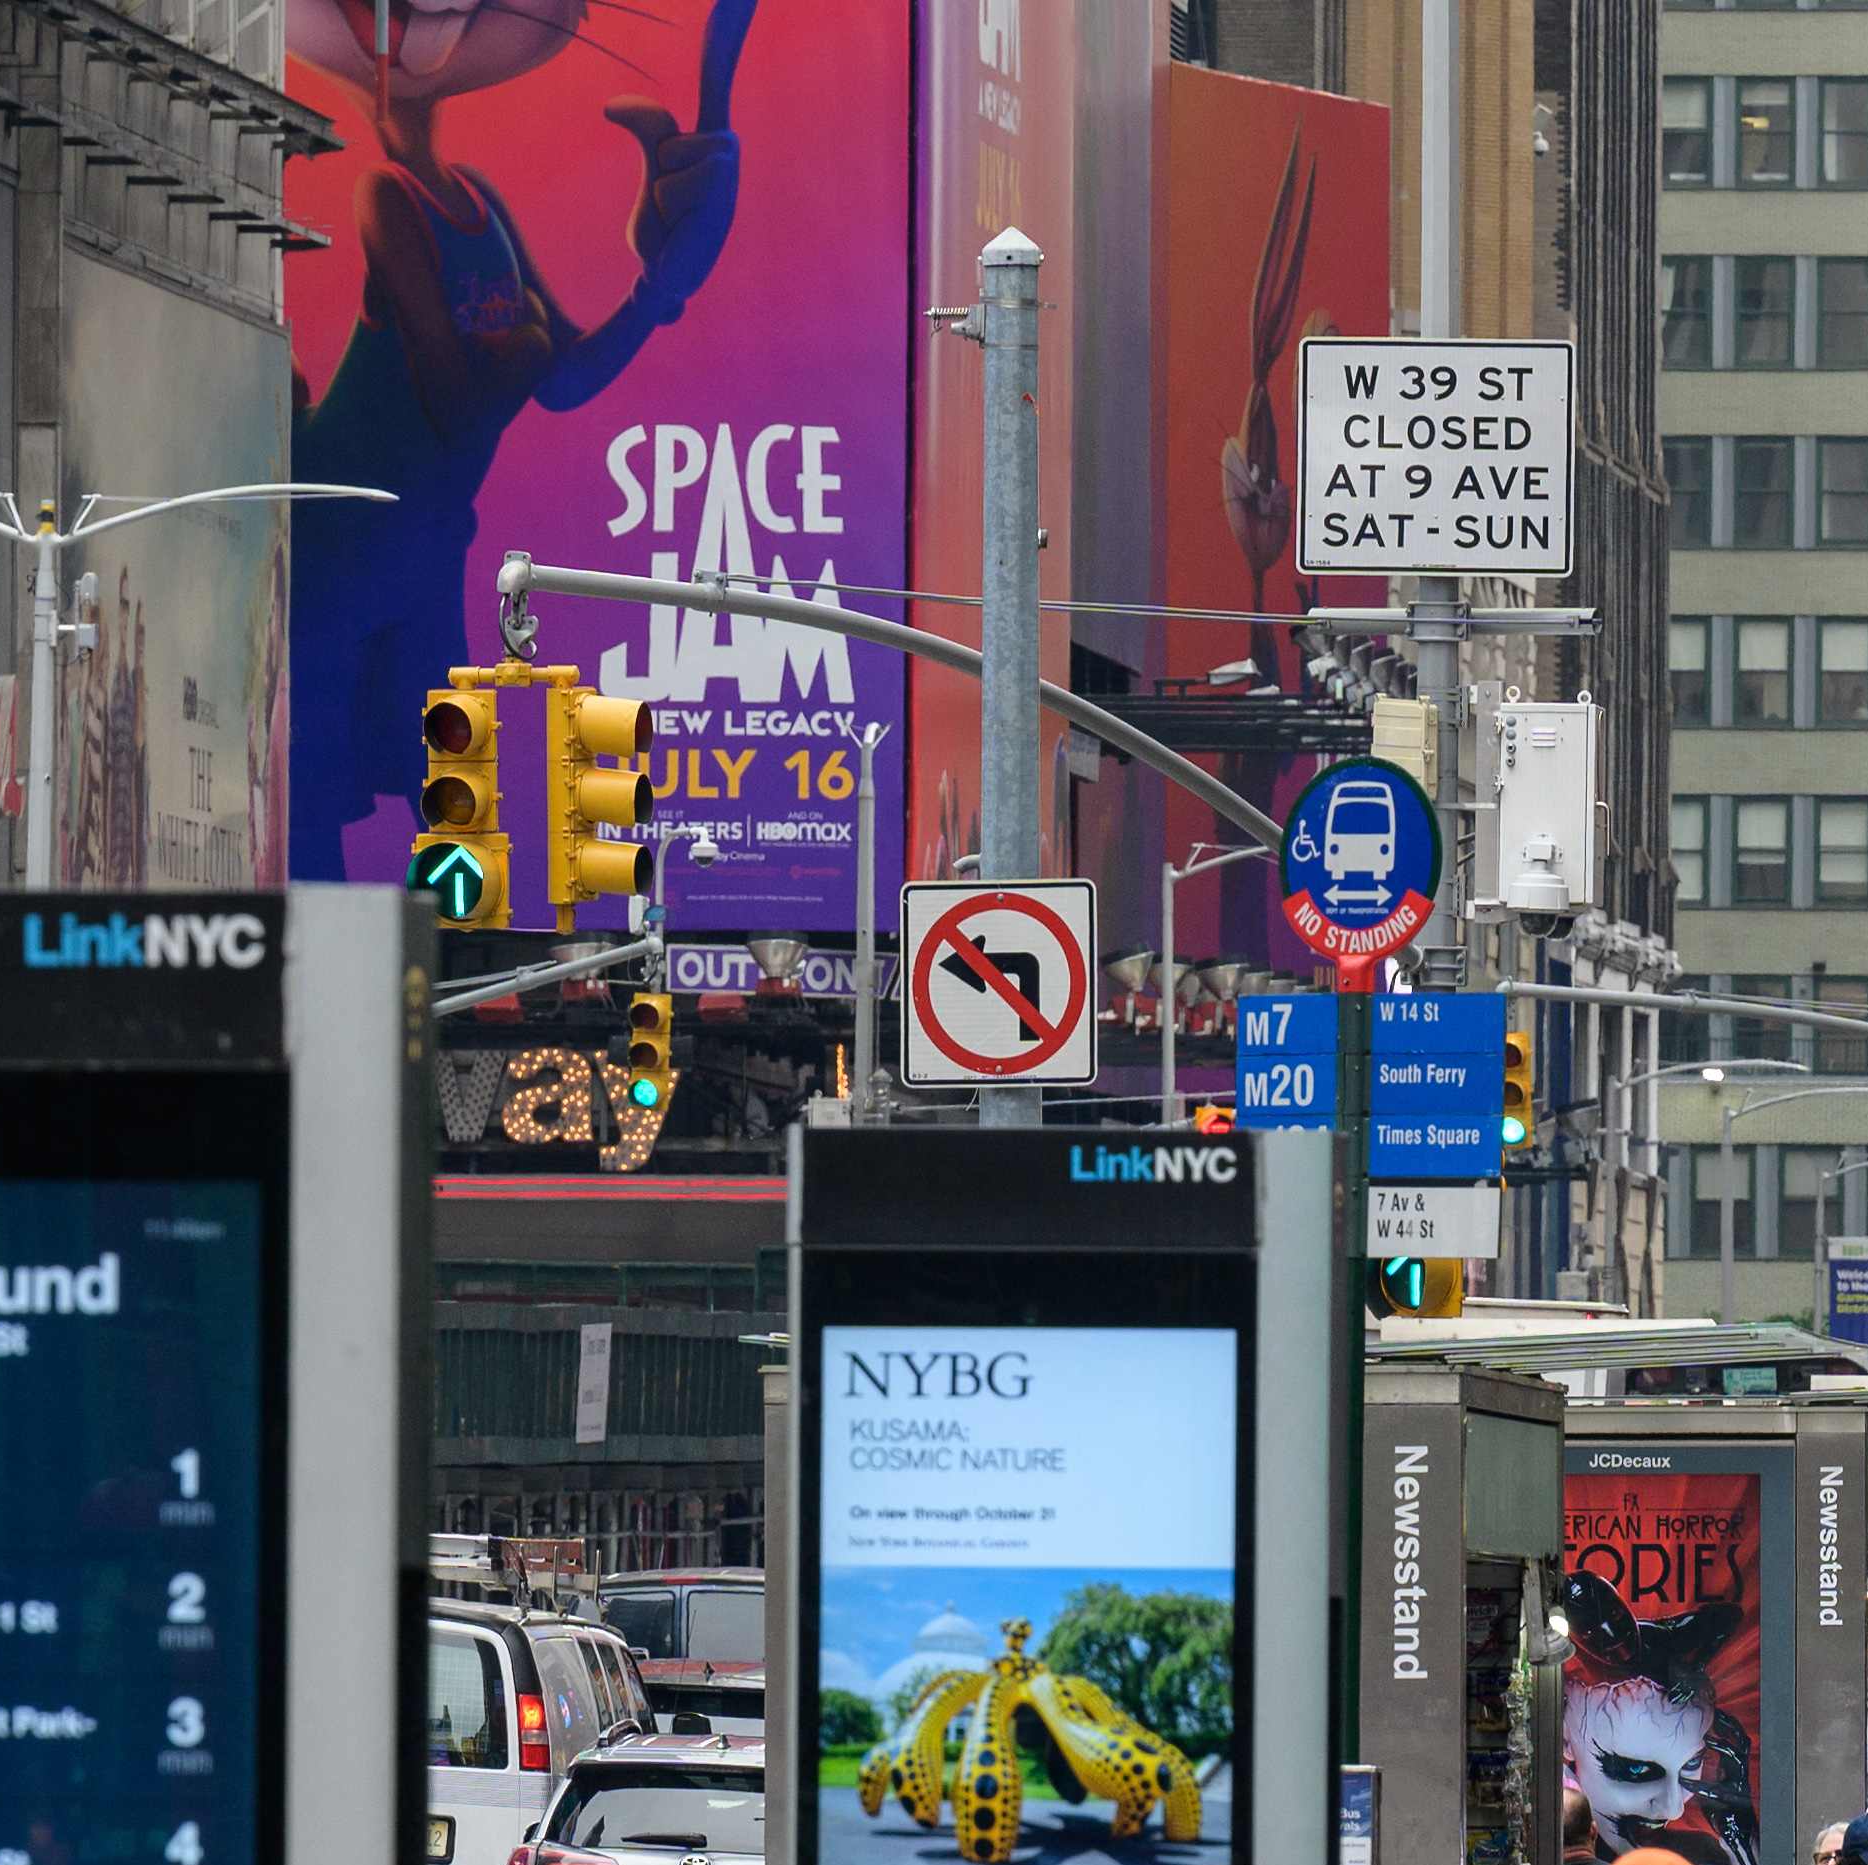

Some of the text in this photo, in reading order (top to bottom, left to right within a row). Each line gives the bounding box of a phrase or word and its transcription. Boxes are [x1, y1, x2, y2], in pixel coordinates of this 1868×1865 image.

[1344, 365, 1534, 401] W 39 ST
[1343, 414, 1531, 451] CLOSED
[606, 423, 844, 537] SPACE
[1324, 464, 1550, 501] AT 9 AVE
[599, 552, 855, 704] JAM
[652, 711, 855, 736] EW LEGACY
[618, 749, 855, 800] ULY 16
[23, 913, 265, 969] LinkNYC
[1294, 902, 1418, 954] NO STANDING
[1246, 1003, 1293, 1046] M7
[1381, 1002, 1440, 1022] W 14 St
[1245, 1064, 1314, 1107] M20
[1380, 1064, 1466, 1088] South Ferry
[1377, 1125, 1480, 1149] Times Square
[1070, 1145, 1237, 1184] LinkNYC
[1378, 1193, 1424, 1212] 7 Av &
[1377, 1220, 1434, 1239] W 44 St
[844, 1350, 1033, 1400] NYBG
[850, 1420, 969, 1443] KUSAMA:
[171, 1449, 199, 1498] 1
[850, 1448, 1066, 1472] COSMIC NATURE
[1589, 1454, 1671, 1468] JCDecaux
[849, 1505, 871, 1520] On
[877, 1507, 907, 1520] view
[914, 1506, 971, 1522] through
[976, 1505, 1034, 1520] October
[1564, 1515, 1641, 1540] ERICAN
[1394, 1445, 1428, 1679] Newsstand
[1819, 1466, 1843, 1626] Newsstand
[1564, 1544, 1745, 1604] ORIES
[23, 1602, 56, 1634] St
[168, 1573, 206, 1622] 2
[167, 1697, 204, 1747] 3
